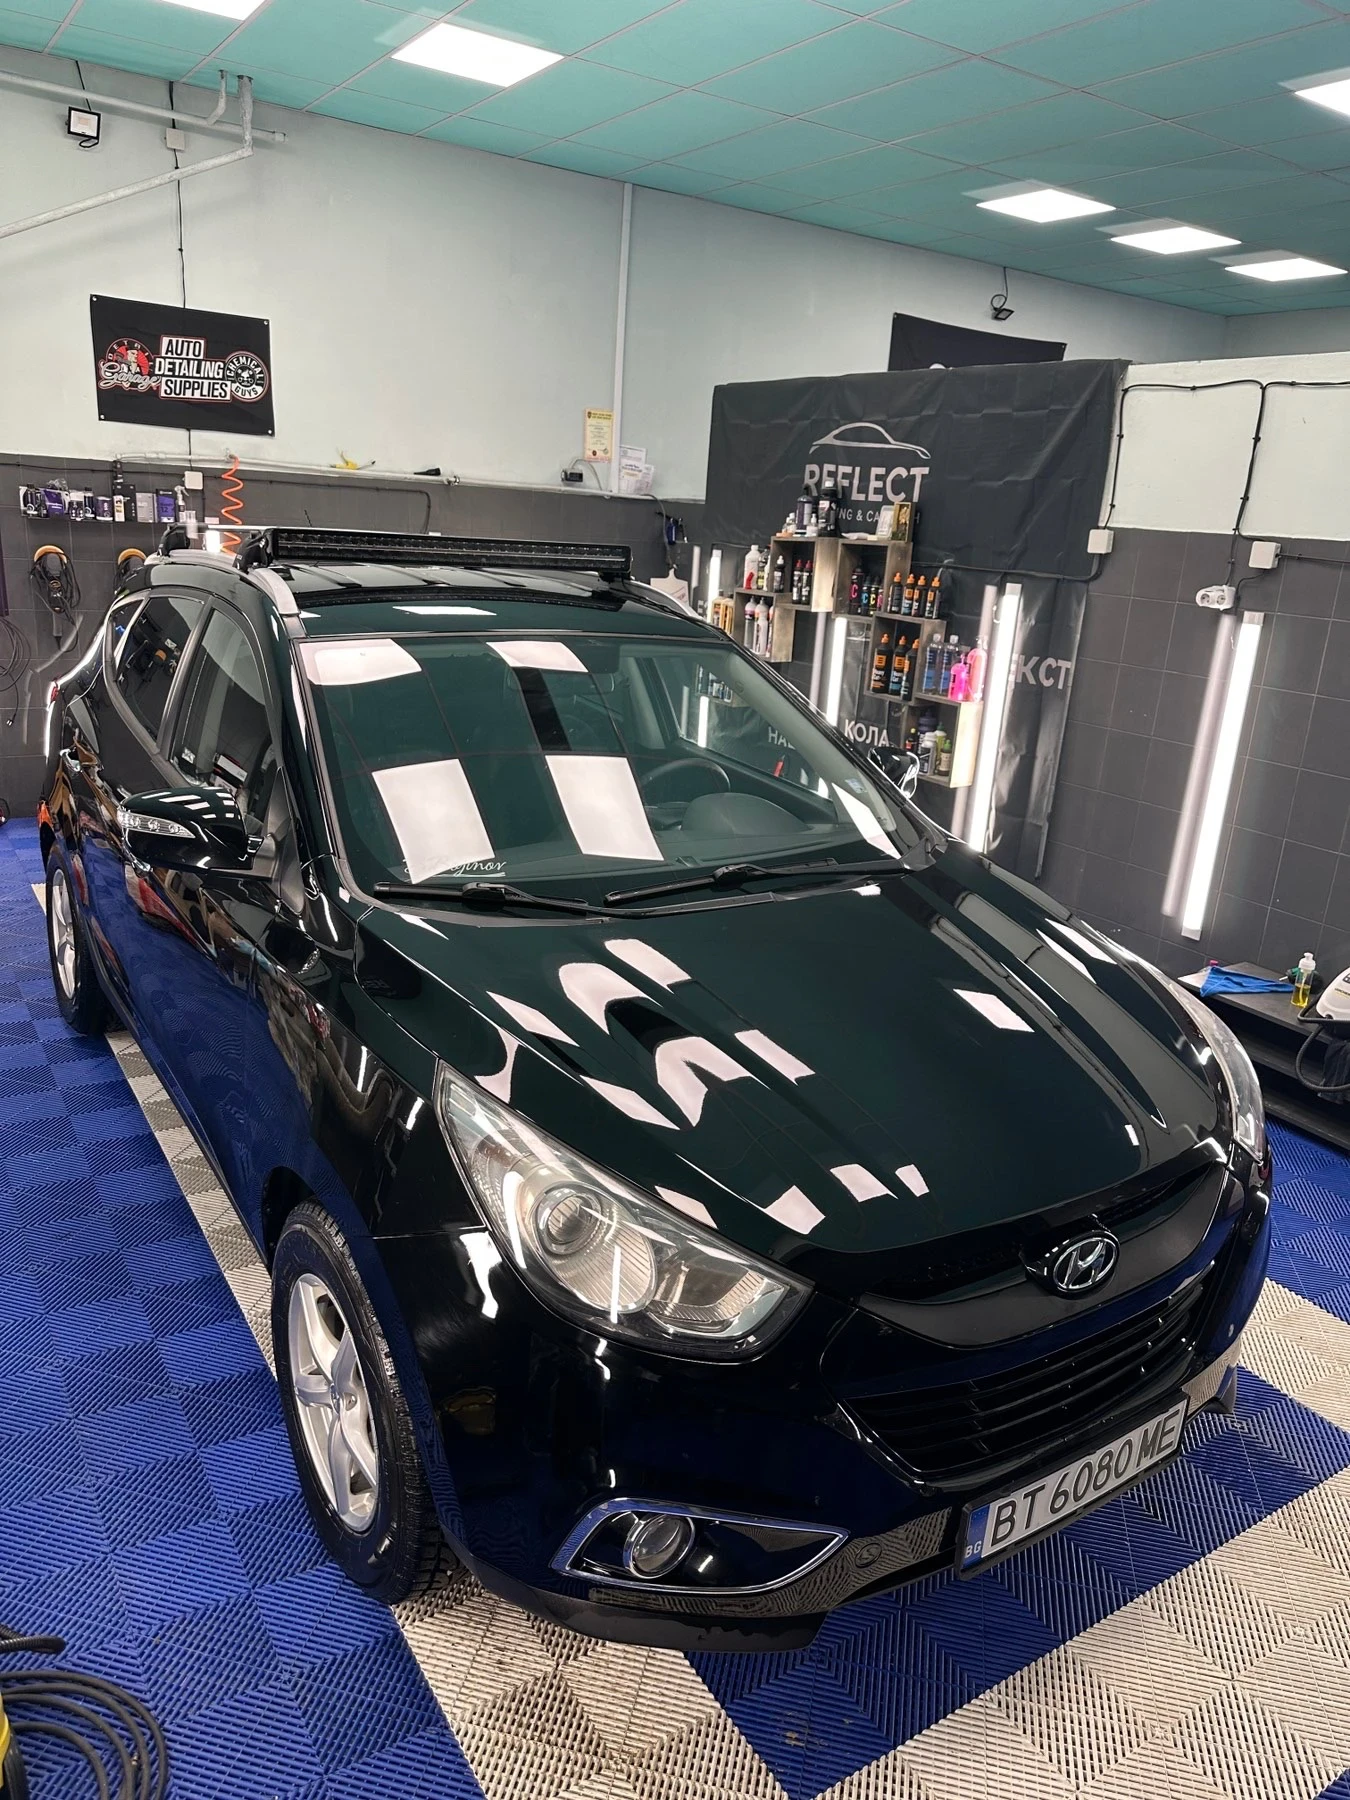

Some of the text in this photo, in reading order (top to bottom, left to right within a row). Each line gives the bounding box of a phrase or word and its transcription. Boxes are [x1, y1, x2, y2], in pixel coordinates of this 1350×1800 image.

[165, 339, 202, 358] AUTO
[100, 361, 161, 390] Garage
[154, 358, 224, 379] DETAILING
[226, 356, 264, 379] CHEMICAL
[164, 379, 228, 399] SUPPLIES
[234, 385, 258, 397] GUYS
[803, 463, 930, 503] REFLECT
[856, 510, 863, 521] &
[844, 719, 890, 748] КОЛА
[991, 1408, 1181, 1547] BT 6080 ME
[964, 1540, 982, 1558] BG
